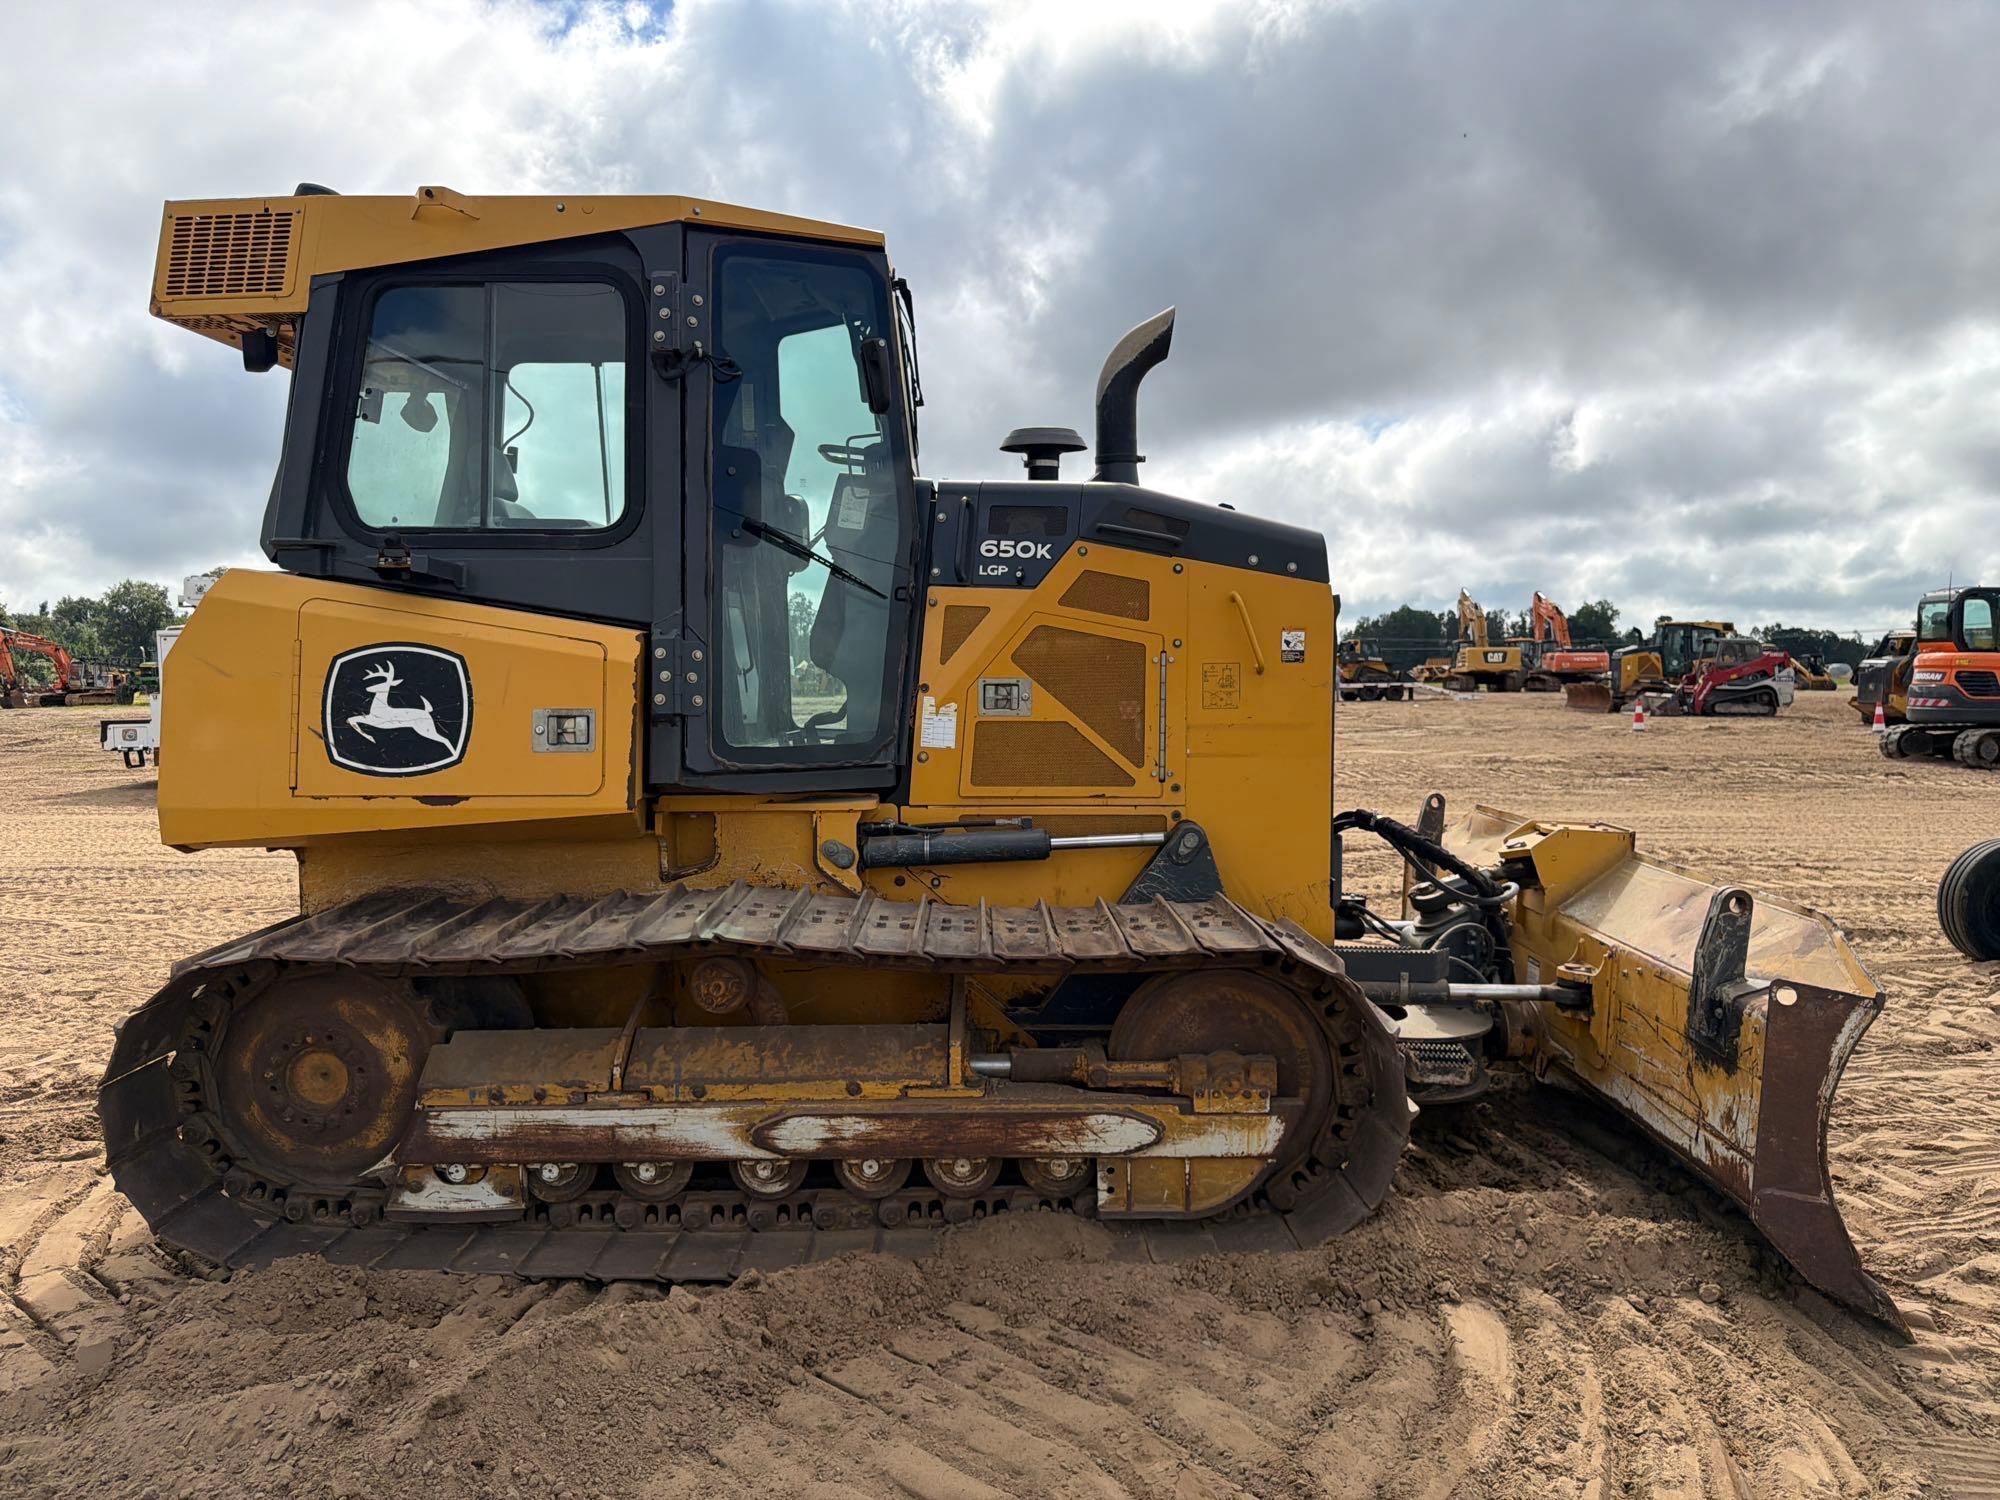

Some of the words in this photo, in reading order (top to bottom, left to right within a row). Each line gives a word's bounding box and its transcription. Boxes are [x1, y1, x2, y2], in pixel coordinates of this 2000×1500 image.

[980, 540, 1052, 559] 650K
[979, 565, 1008, 576] LGP
[1487, 652, 1503, 662] CAT
